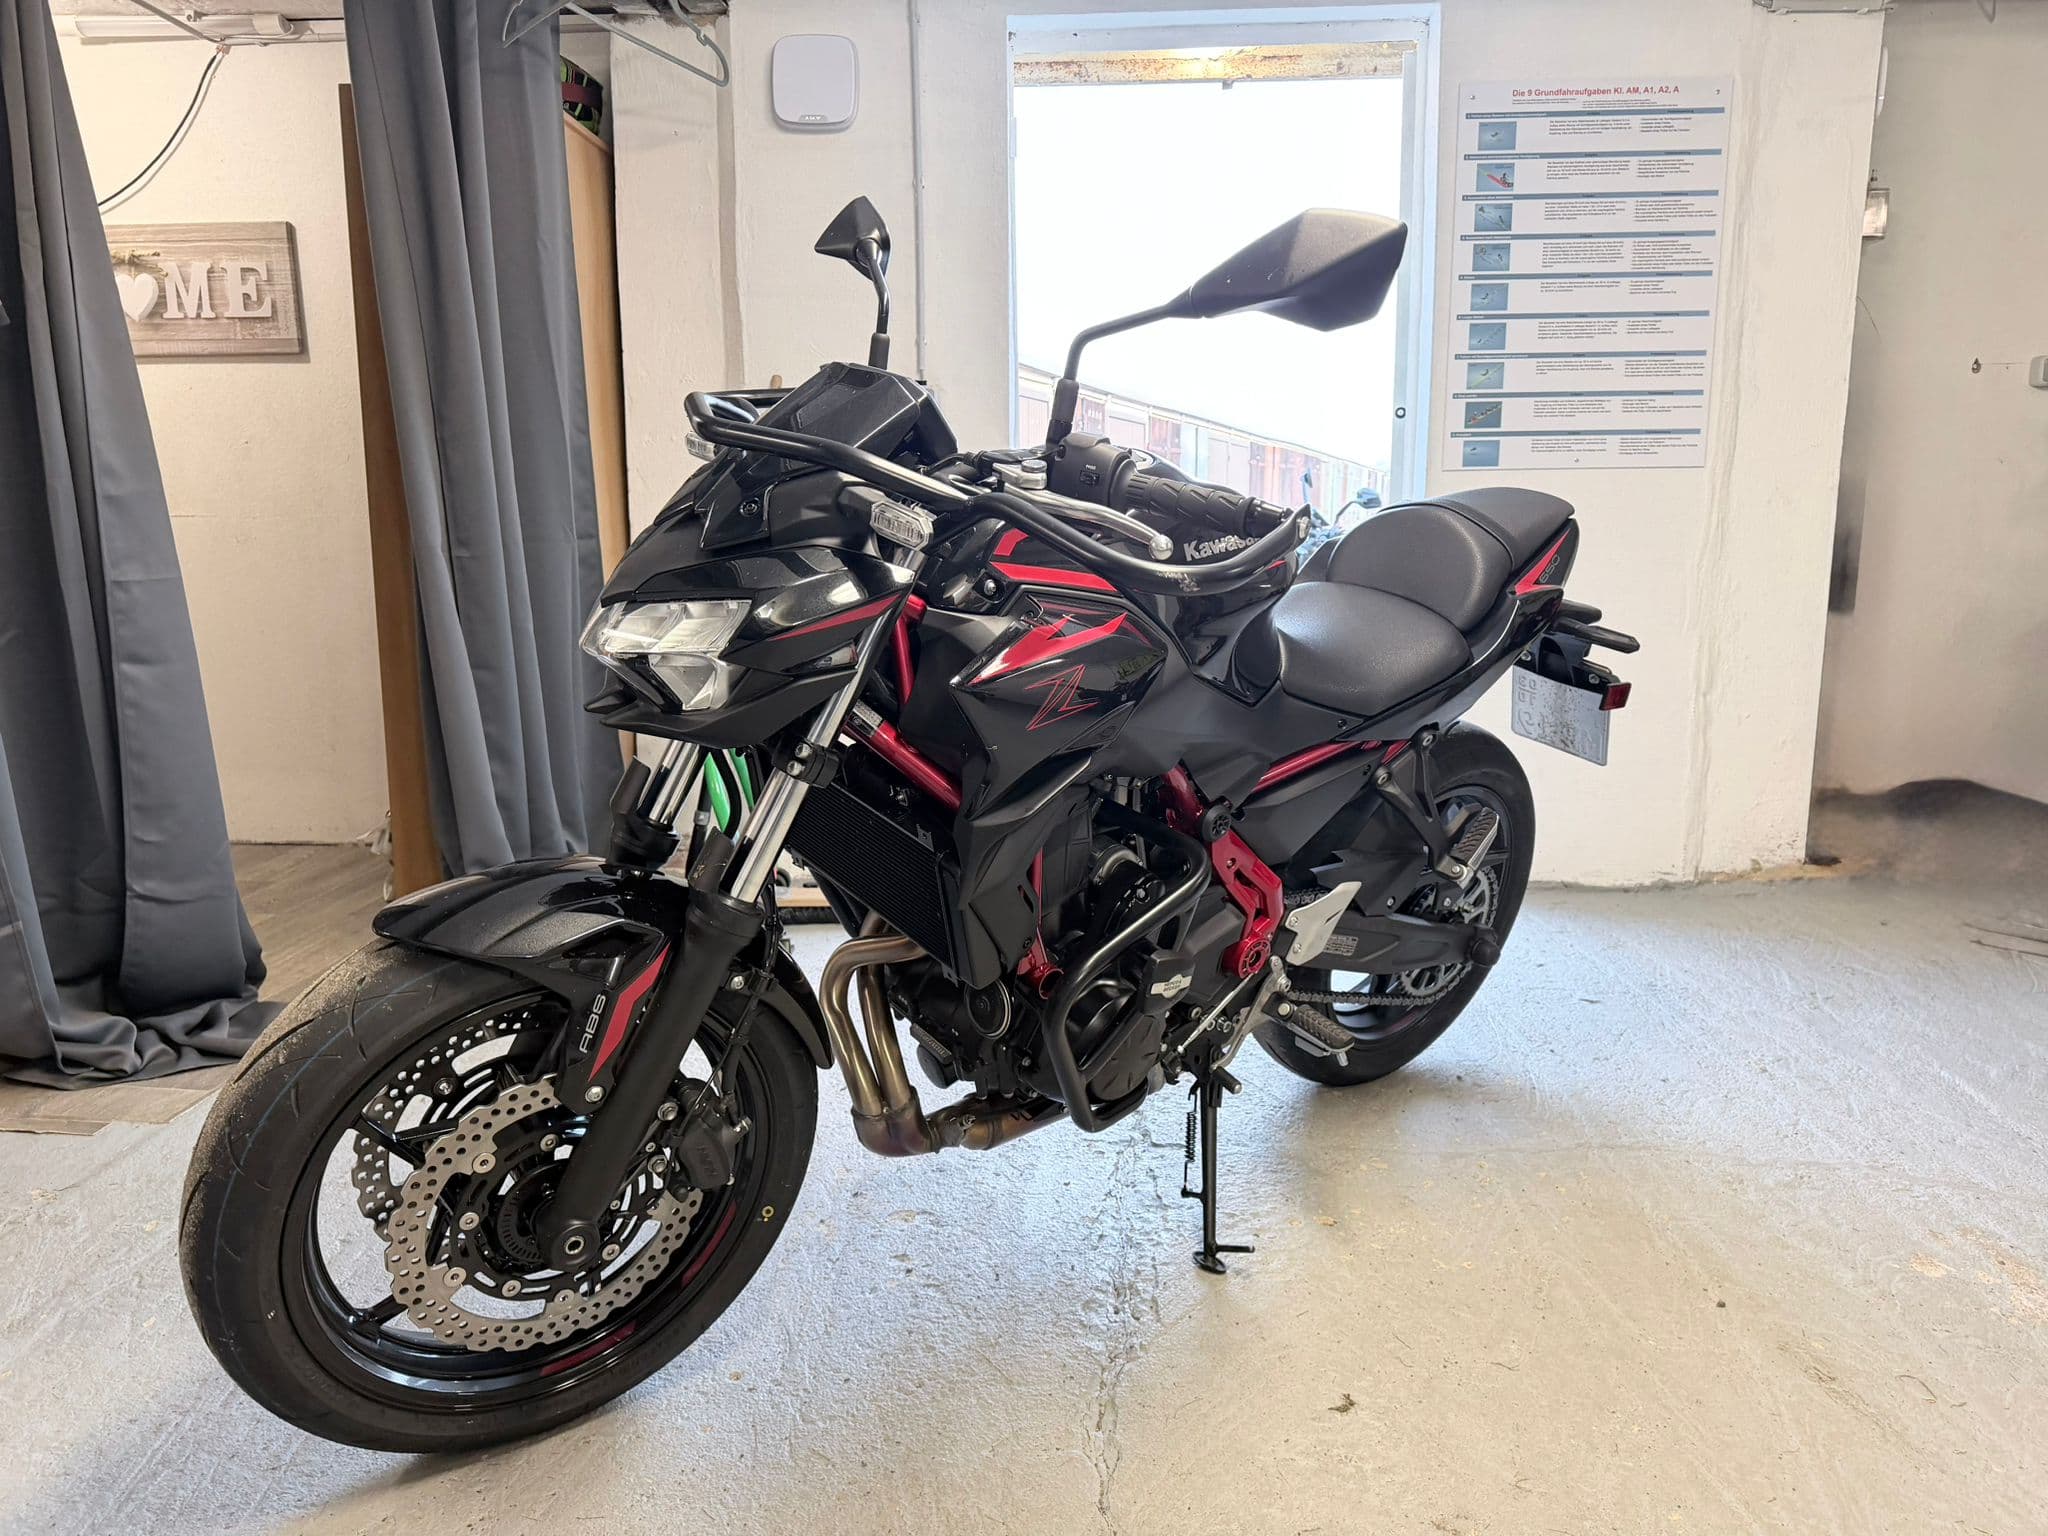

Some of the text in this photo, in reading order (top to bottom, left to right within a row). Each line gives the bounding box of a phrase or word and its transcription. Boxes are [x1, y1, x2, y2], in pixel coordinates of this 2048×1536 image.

[1512, 89, 1525, 97] Die
[1534, 87, 1612, 97] Grundfahraufgaben
[1626, 87, 1641, 95] AM,
[1643, 86, 1656, 94] A1,
[1658, 86, 1671, 94] A2,
[1183, 536, 1261, 562] Kawasa
[1539, 553, 1561, 584] 650
[579, 993, 607, 1054] ABS
